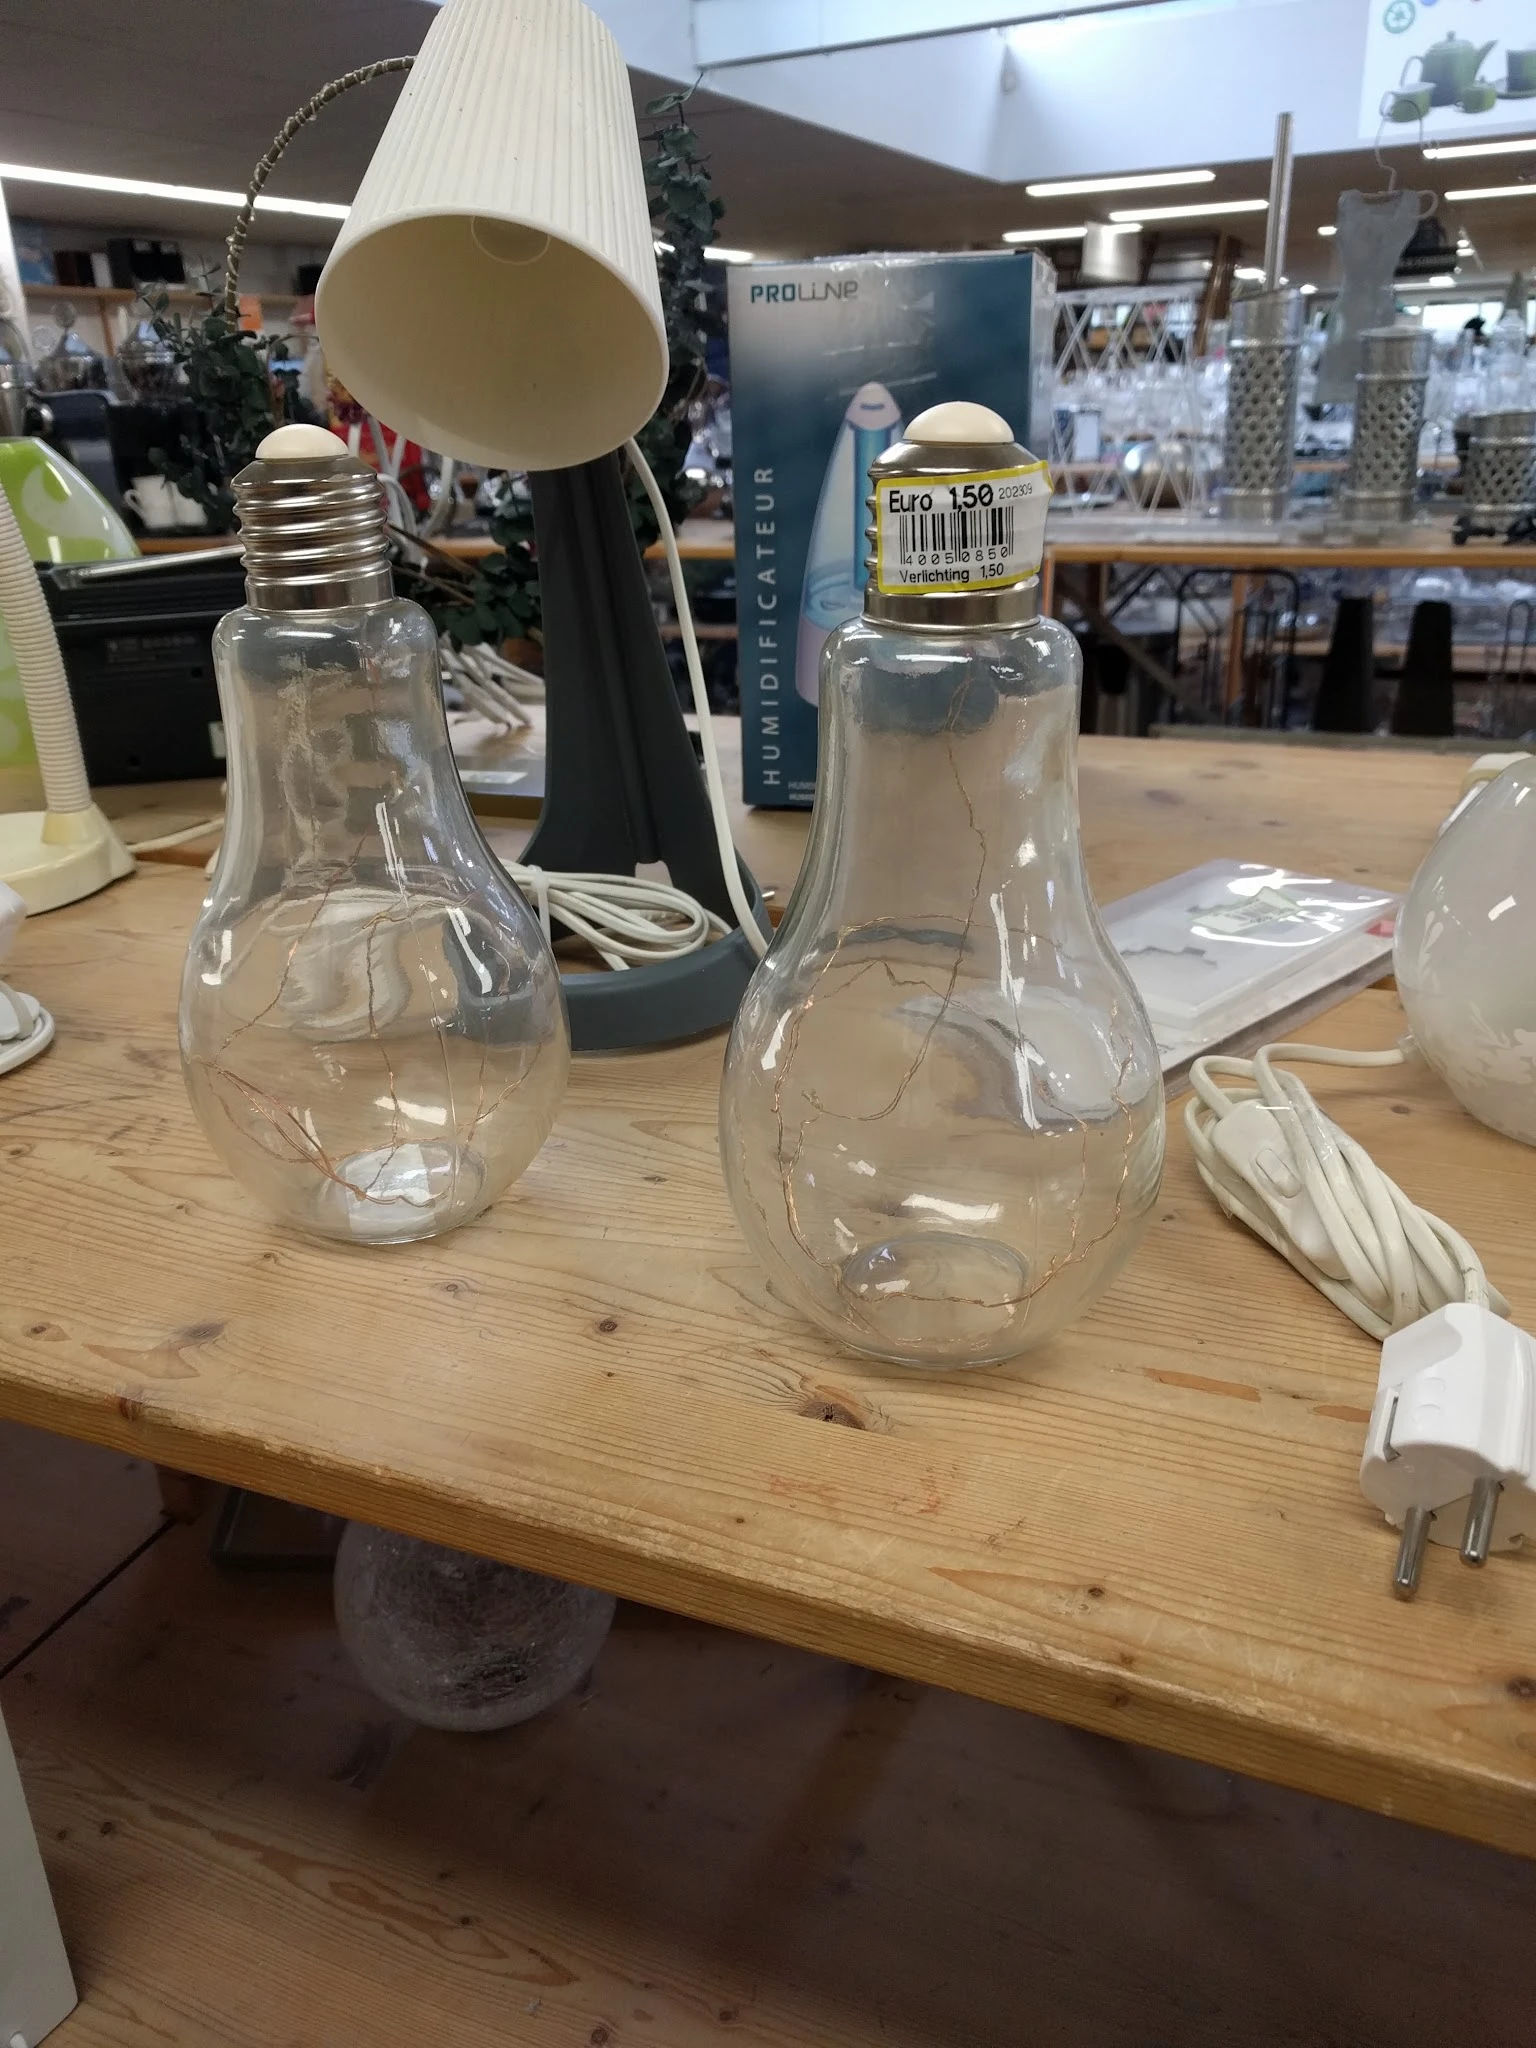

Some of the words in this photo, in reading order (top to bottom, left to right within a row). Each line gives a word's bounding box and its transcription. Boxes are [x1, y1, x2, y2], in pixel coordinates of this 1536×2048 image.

[889, 490, 933, 513] Euro
[949, 484, 994, 512] 1,50
[998, 483, 1033, 499] 202309
[900, 569, 970, 583] Verlichting
[980, 563, 1004, 579] 1,50
[754, 467, 781, 785] HUMIDIFICATEUR
